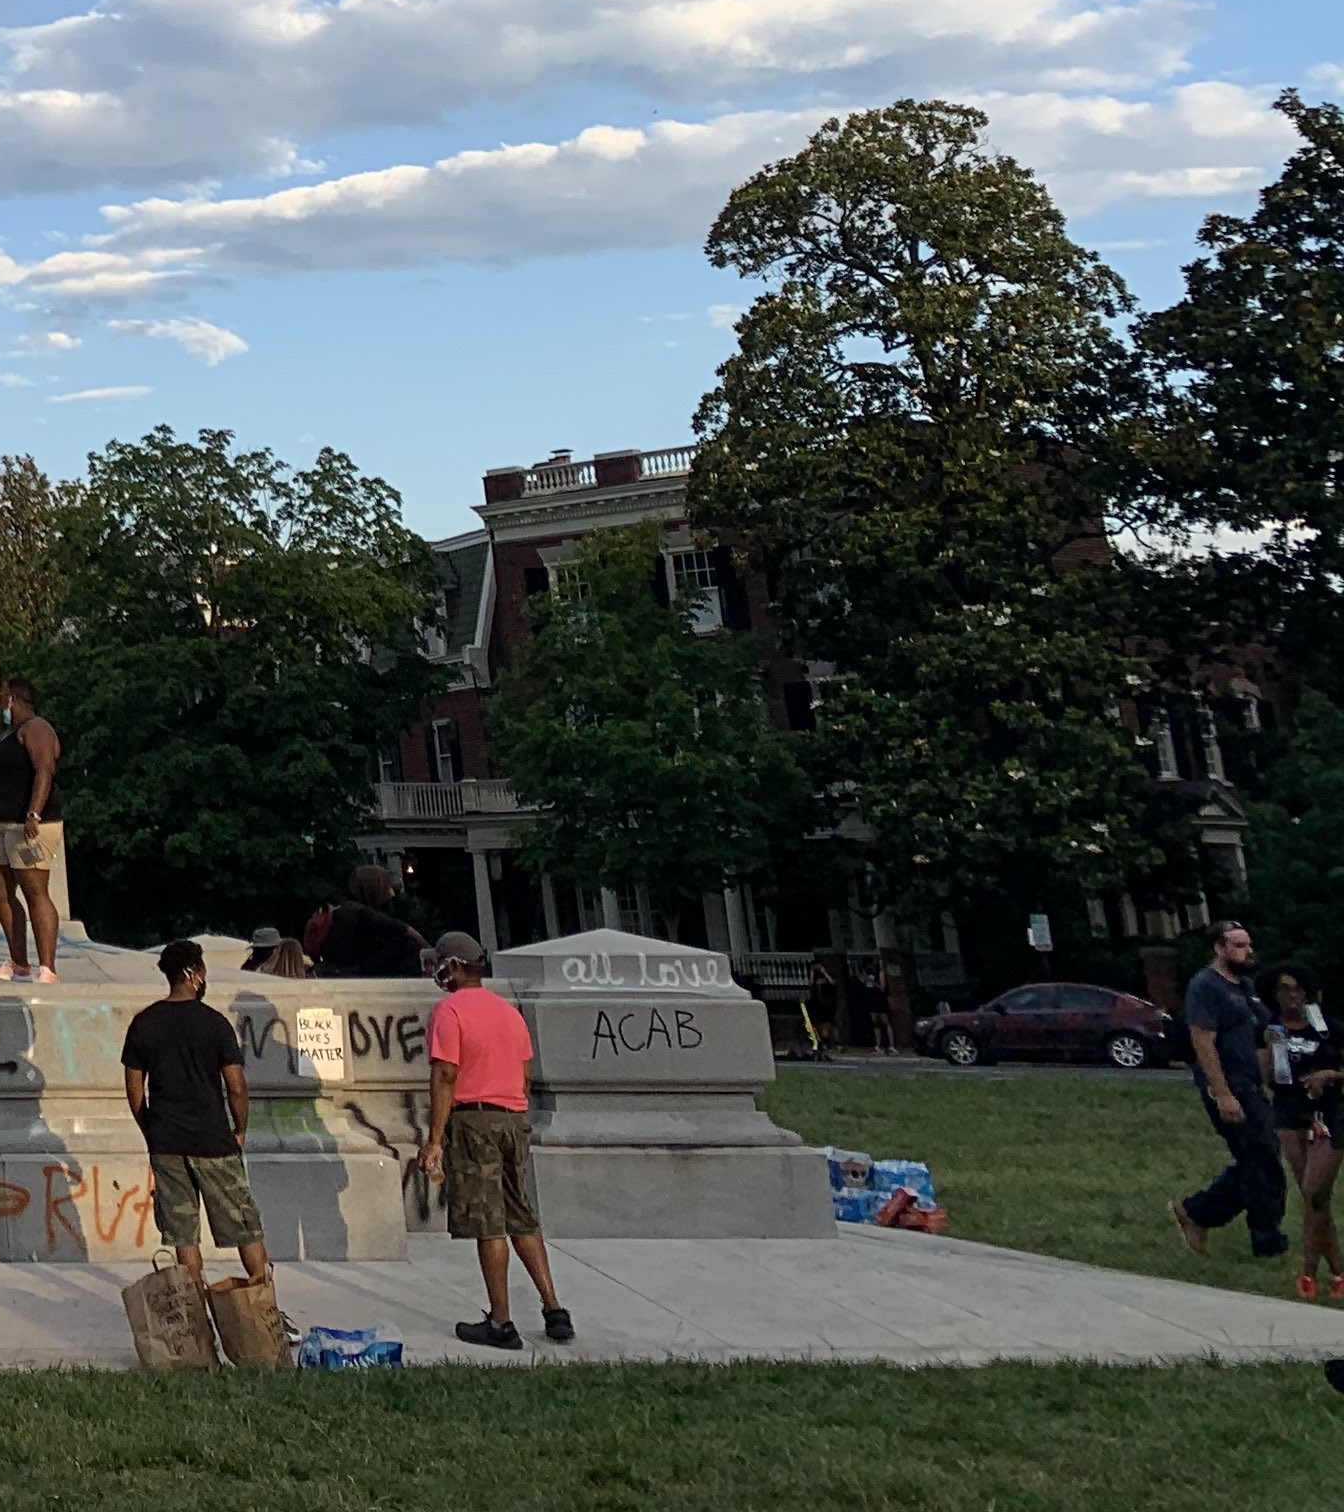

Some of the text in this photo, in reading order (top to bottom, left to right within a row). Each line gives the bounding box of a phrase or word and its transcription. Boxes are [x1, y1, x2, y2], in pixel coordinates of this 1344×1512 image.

[562, 953, 623, 987] all
[299, 1018, 334, 1031] BLACK
[591, 1010, 704, 1060] ACAB
[299, 1032, 331, 1045] LIVES
[347, 1010, 426, 1065] OVE
[300, 1046, 345, 1061] MATTER
